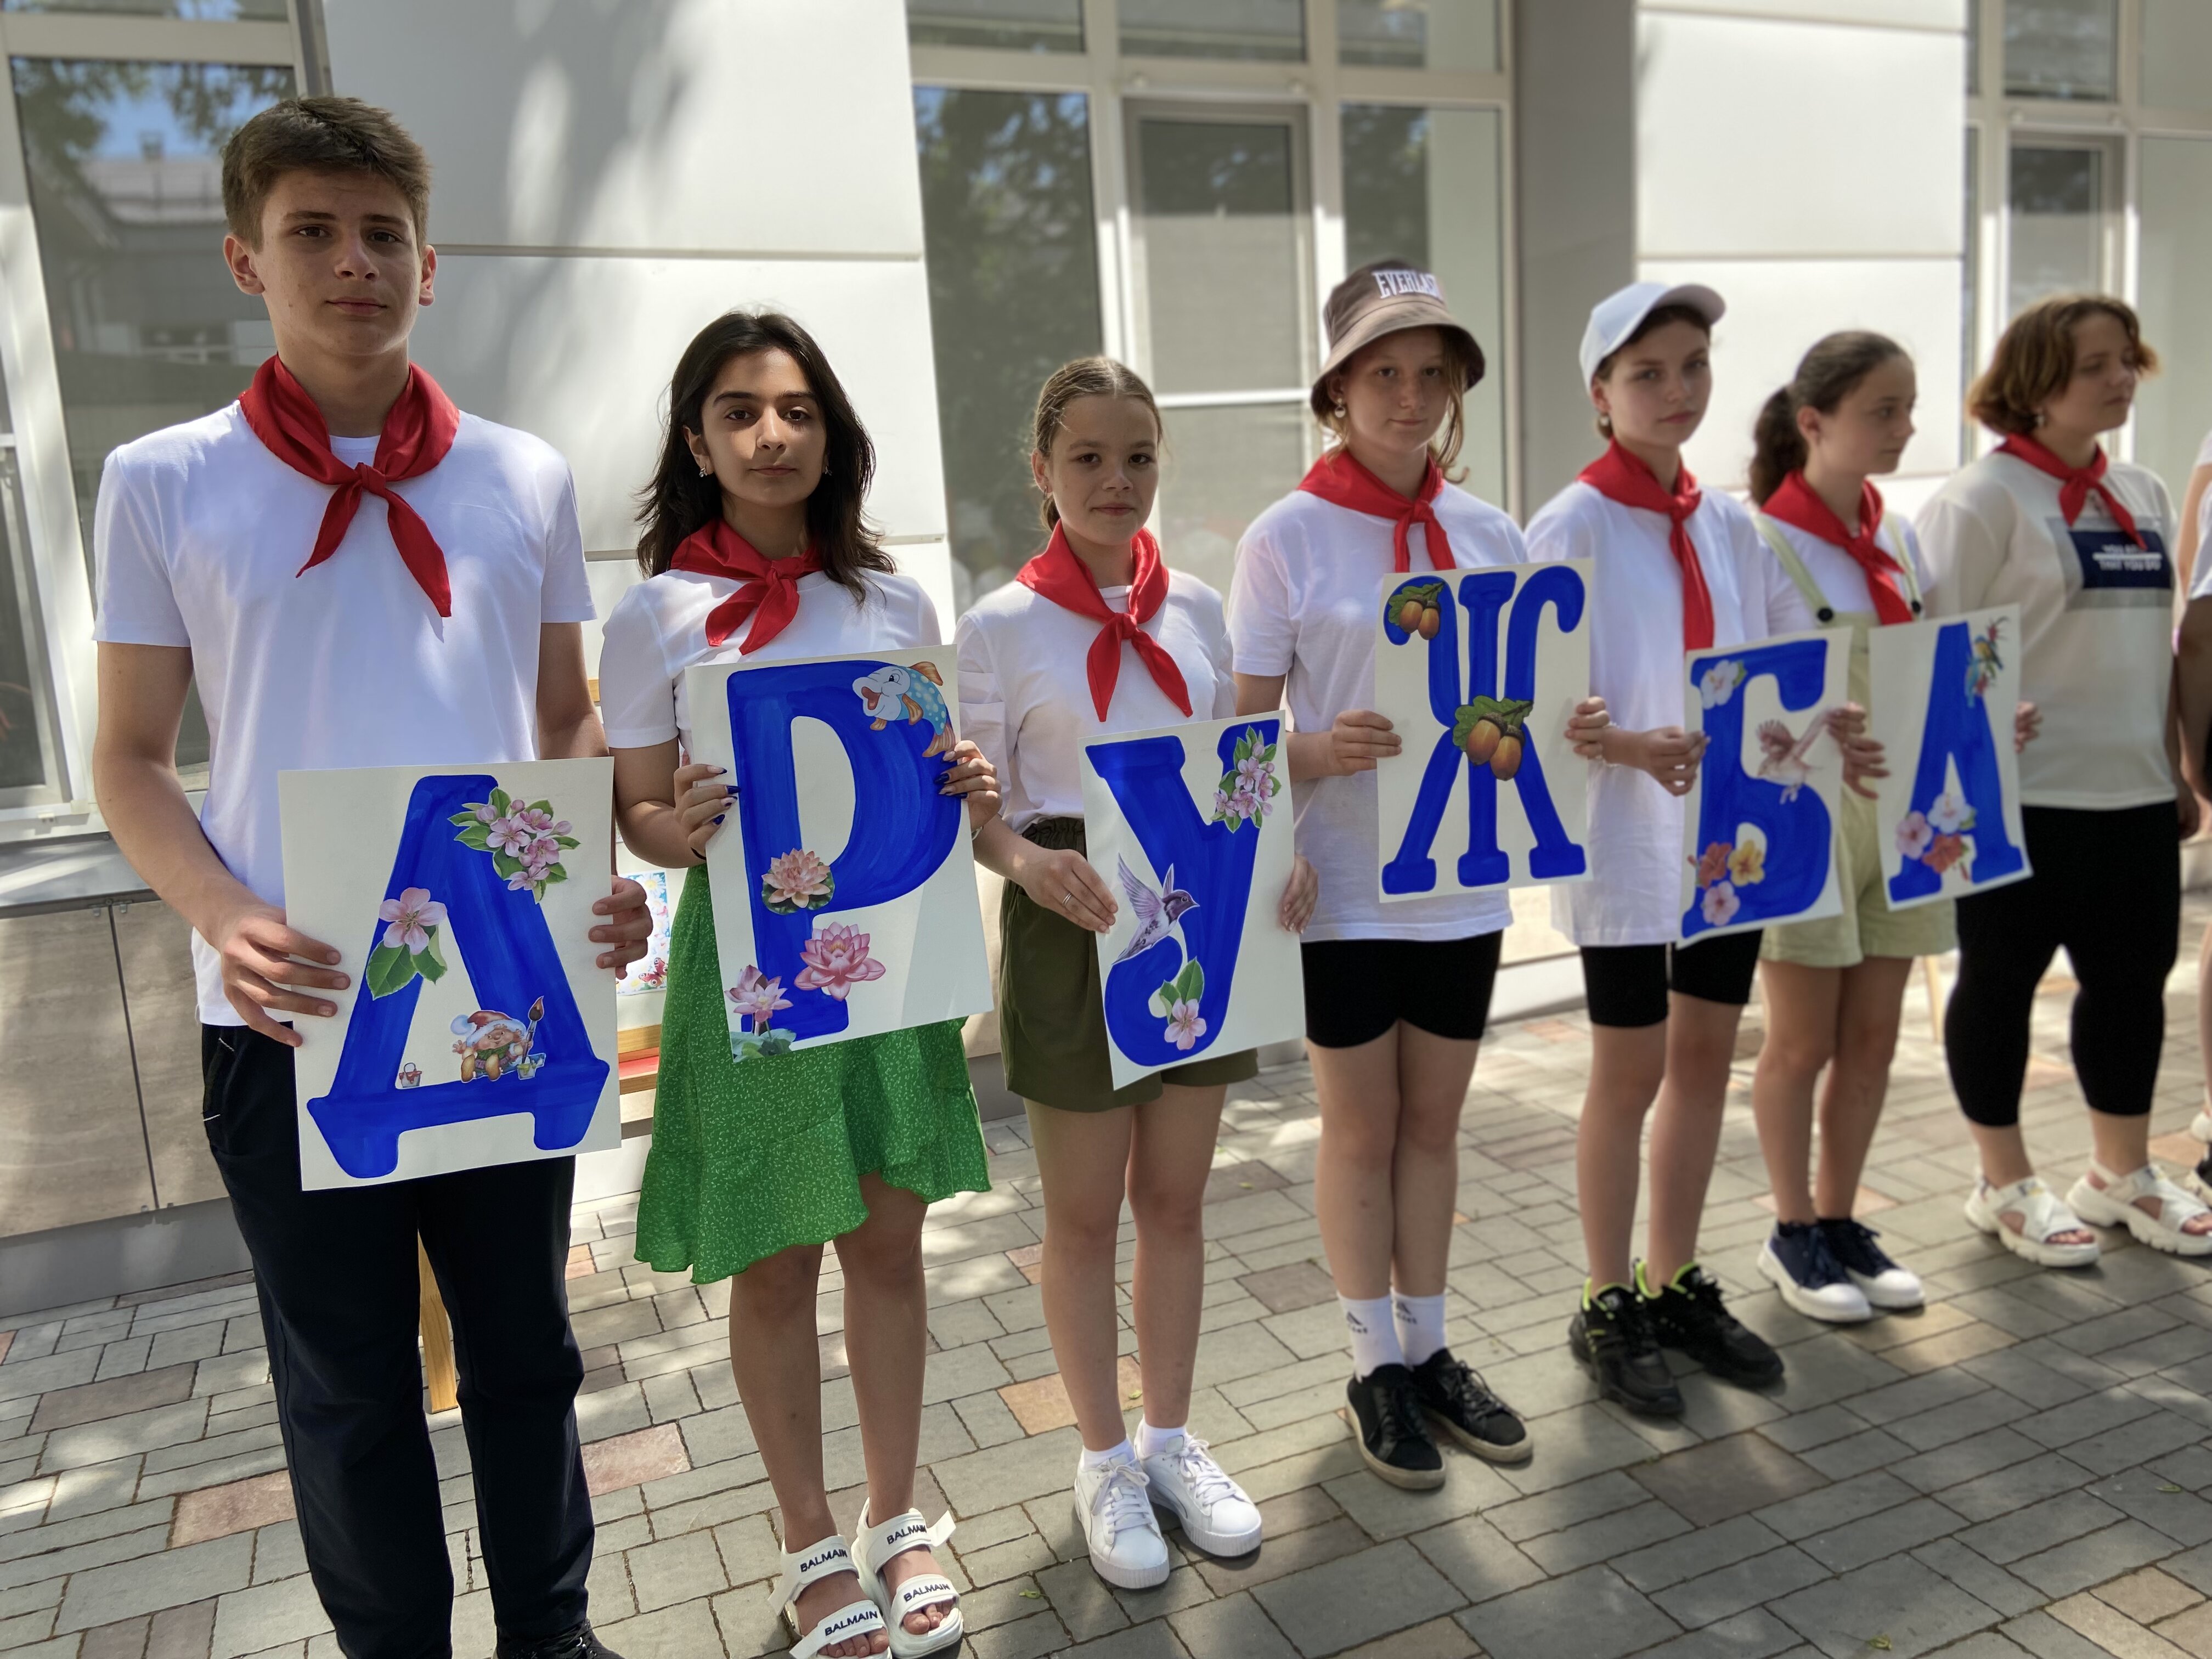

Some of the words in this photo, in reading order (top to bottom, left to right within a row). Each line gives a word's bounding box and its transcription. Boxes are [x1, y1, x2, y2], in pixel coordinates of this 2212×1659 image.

[1372, 269, 1441, 300] EVERLAS
[800, 1549, 848, 1572] BALMAIN
[904, 1583, 951, 1602] BALMAIN
[825, 1610, 878, 1636] BALMAIN
